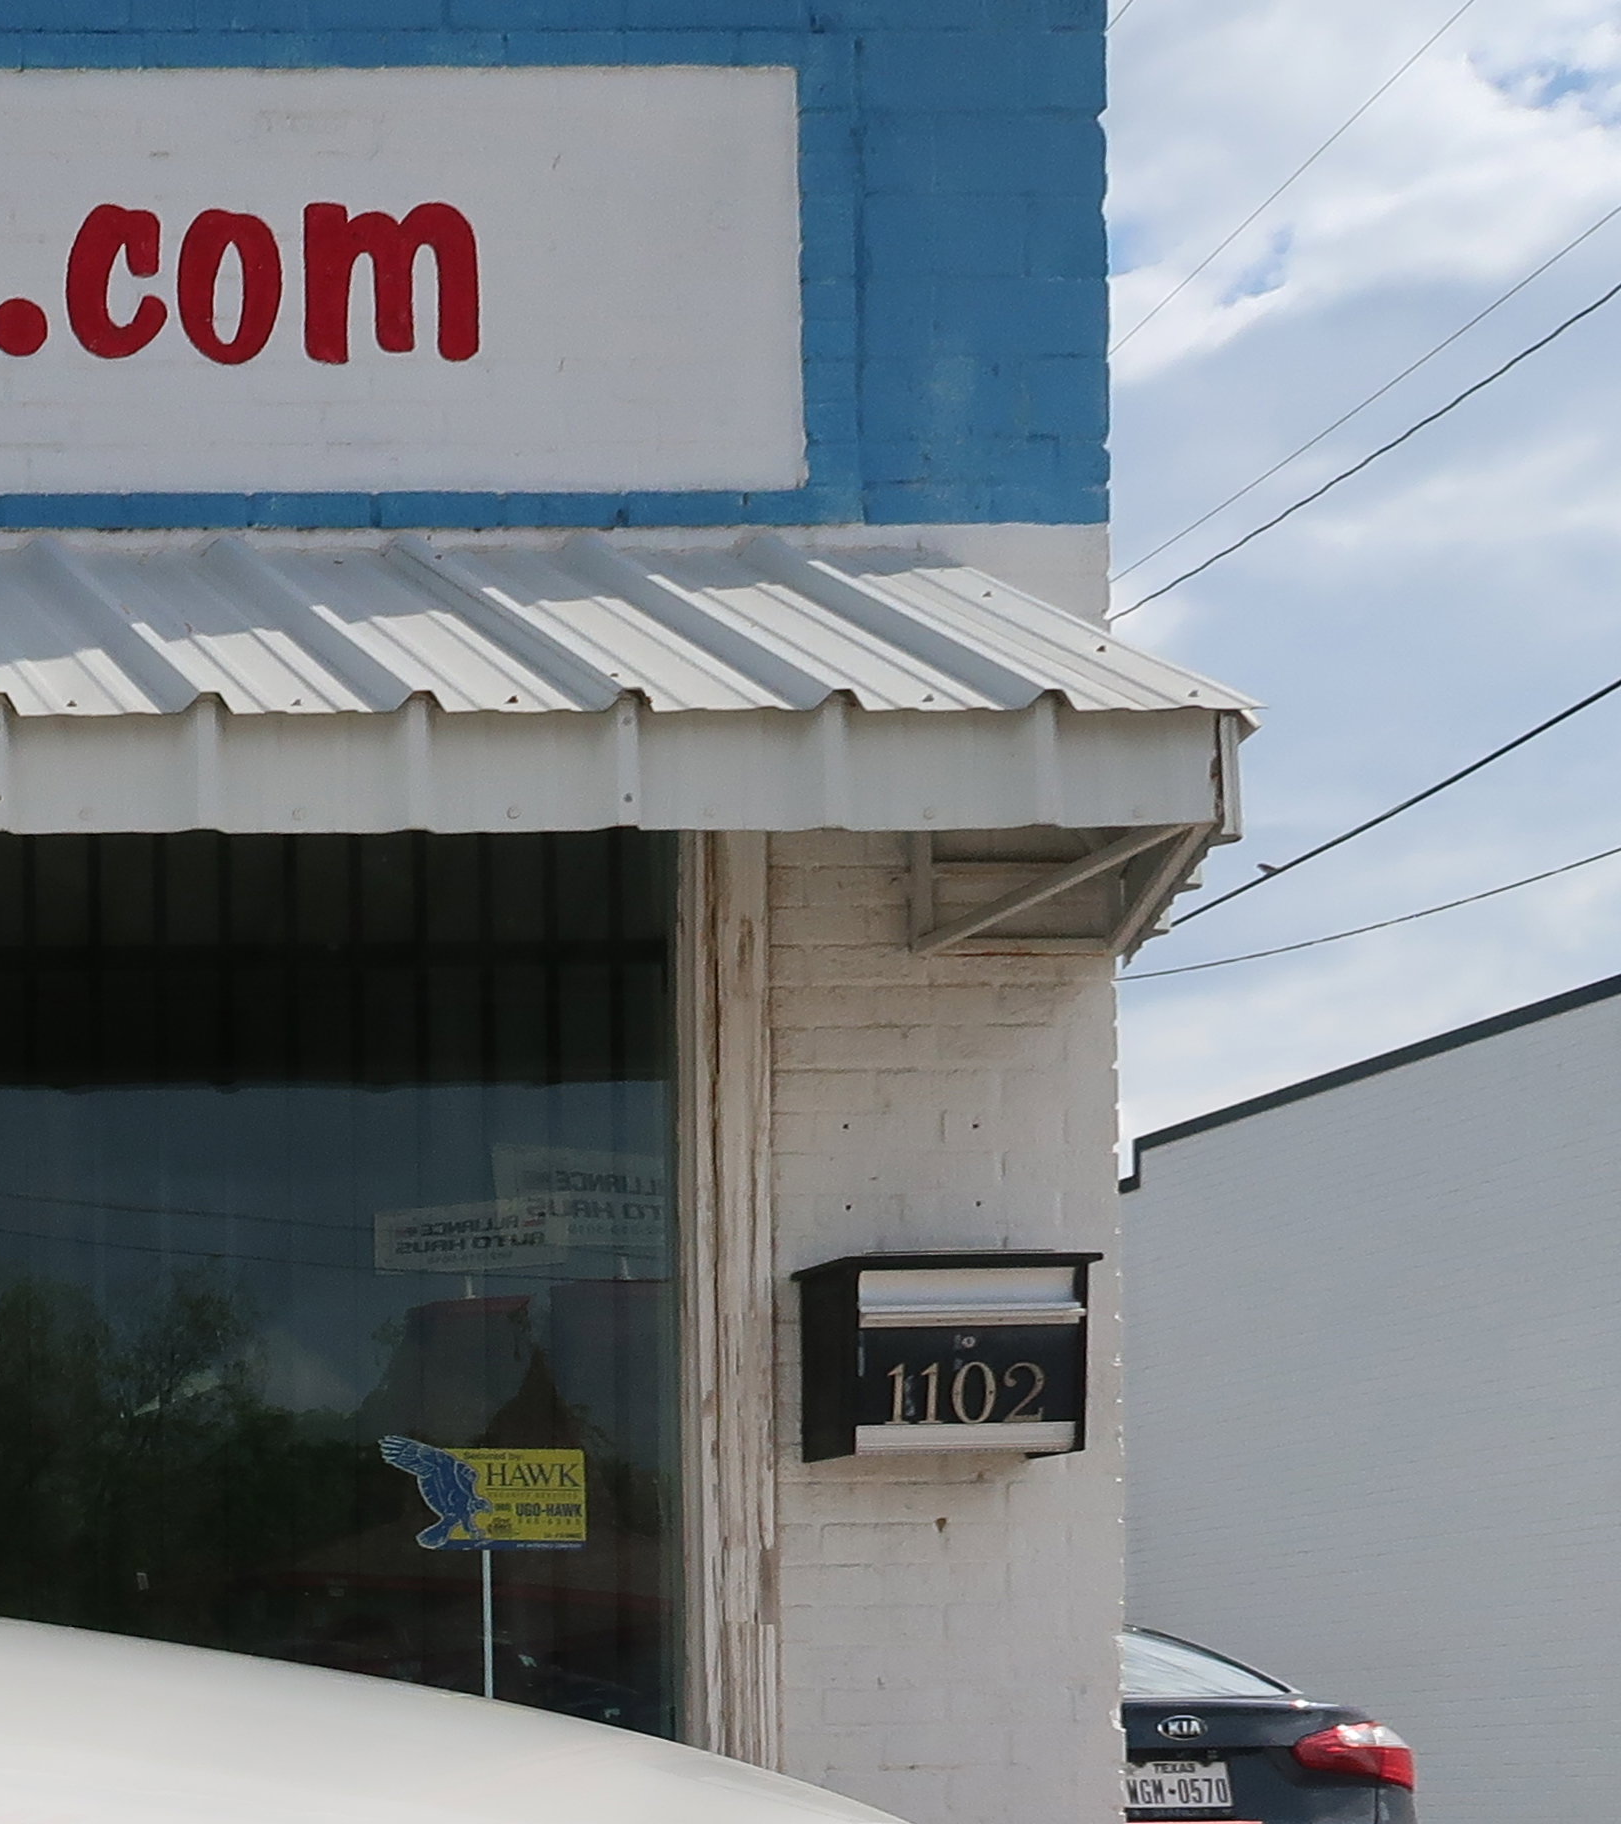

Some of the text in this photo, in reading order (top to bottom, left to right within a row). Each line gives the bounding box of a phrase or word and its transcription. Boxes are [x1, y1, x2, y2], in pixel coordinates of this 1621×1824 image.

[884, 1360, 1046, 1425] 1102
[485, 1462, 582, 1488] HAWK
[1167, 1719, 1203, 1736] KIA
[1152, 1762, 1197, 1774] TEXAS
